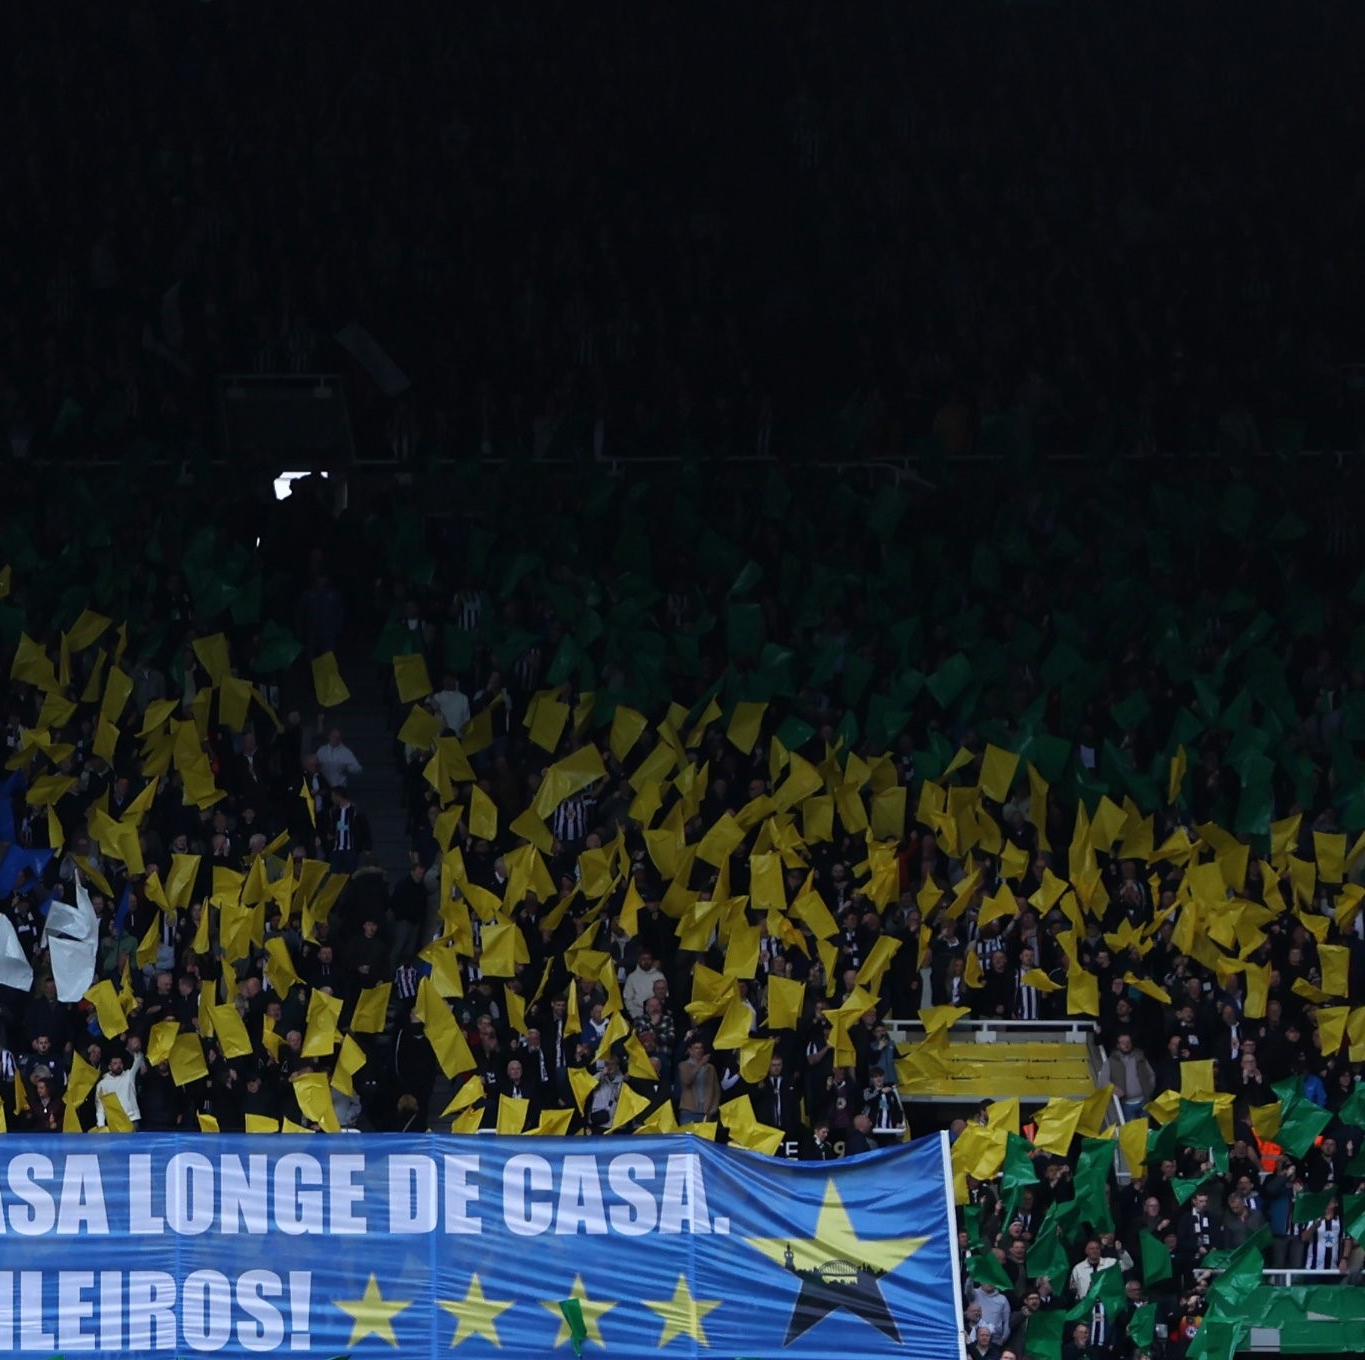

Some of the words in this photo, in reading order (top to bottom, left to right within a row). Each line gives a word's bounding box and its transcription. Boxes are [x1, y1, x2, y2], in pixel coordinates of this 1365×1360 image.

[130, 1152, 368, 1236] LONGE
[389, 1154, 482, 1235] DE
[503, 1153, 730, 1237] CASA.
